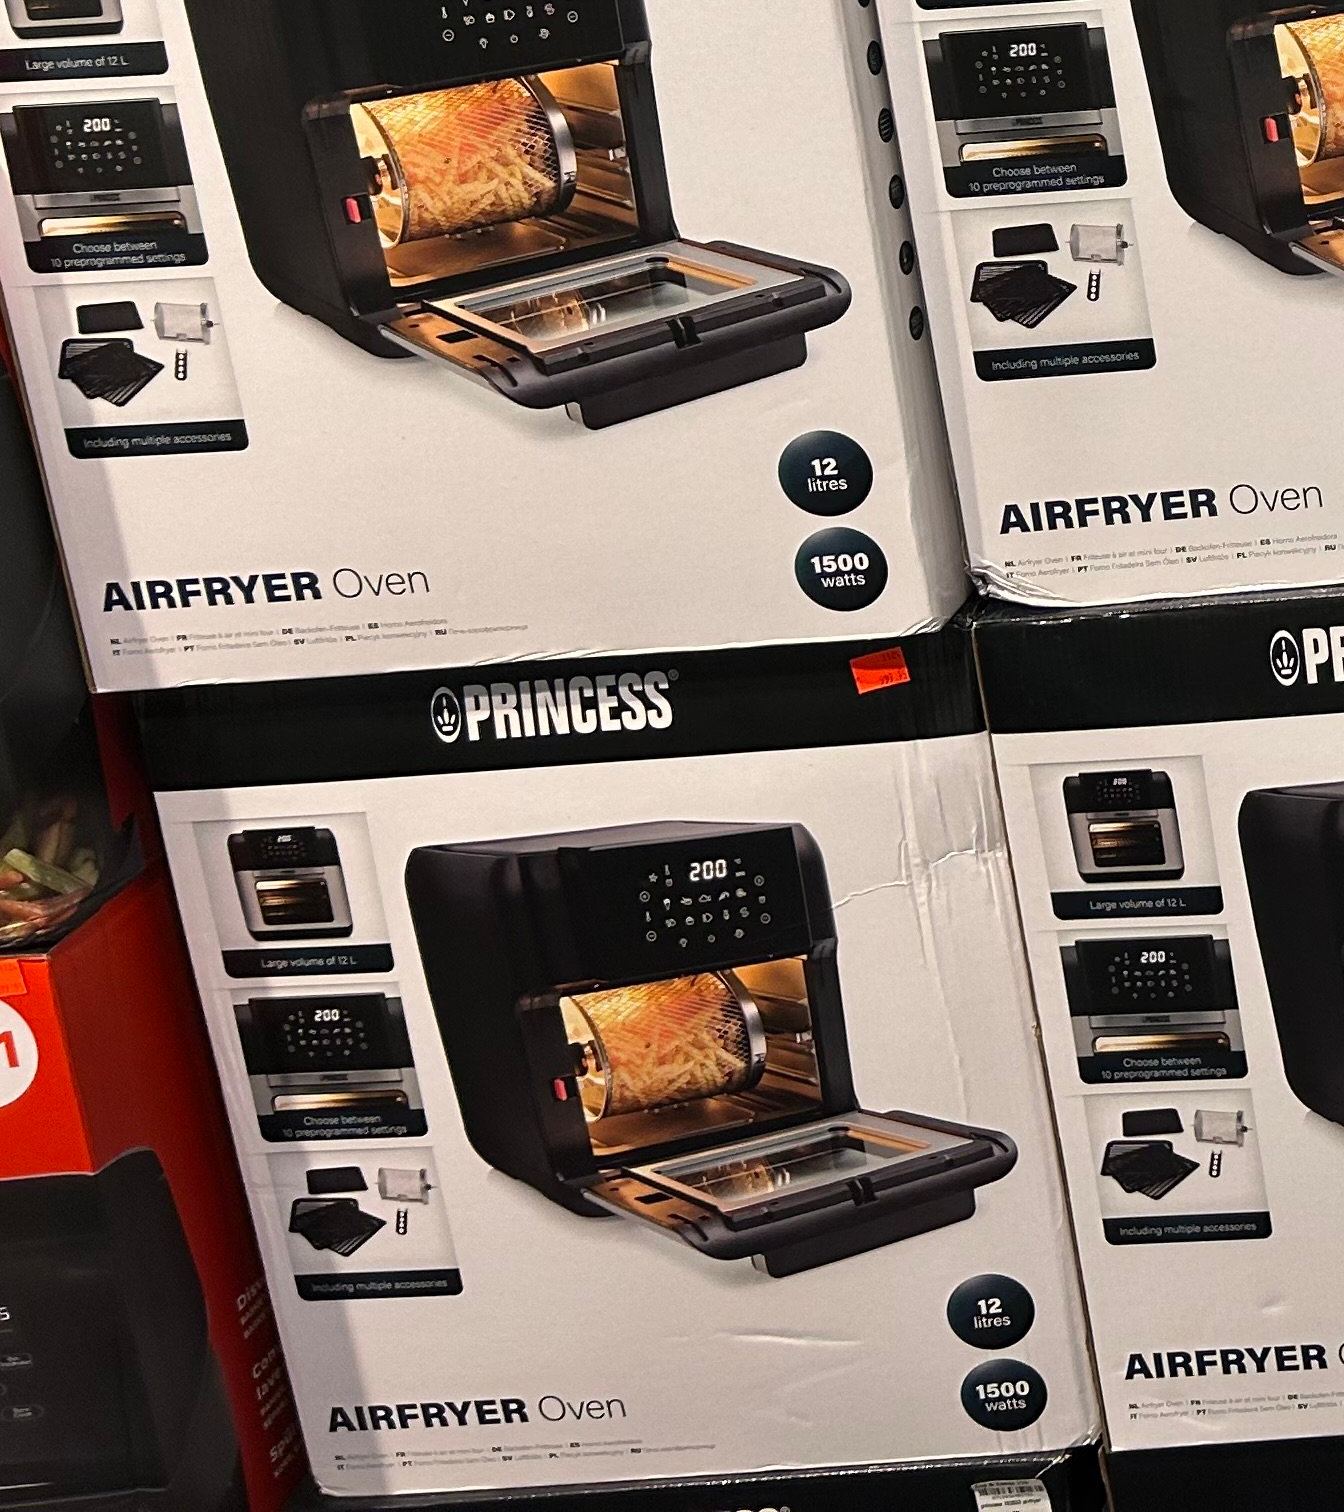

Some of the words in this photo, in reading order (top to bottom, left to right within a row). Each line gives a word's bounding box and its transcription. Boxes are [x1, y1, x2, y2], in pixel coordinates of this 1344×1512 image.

[25, 59, 55, 71] Large
[56, 57, 93, 69] volume
[95, 56, 105, 67] of
[107, 56, 118, 65] 12
[120, 55, 129, 65] L
[992, 166, 1031, 178] Choose
[1033, 164, 1078, 175] between
[983, 177, 1064, 193] preprogrammed
[1065, 175, 1105, 188] settings
[72, 242, 111, 254] Choose
[113, 240, 157, 252] between
[64, 254, 144, 269] preprogrammed
[146, 252, 186, 264] settings
[992, 359, 1038, 371] Including
[1039, 356, 1079, 368] multiple
[1082, 351, 1140, 364] accessories
[84, 437, 130, 449] Including
[131, 435, 171, 447] multiple
[173, 433, 232, 444] accessories
[811, 457, 838, 476] 12
[807, 475, 848, 492] litres
[1000, 487, 1219, 534] AIRFRYER
[1229, 483, 1323, 515] Oven
[810, 552, 869, 574] 1500
[821, 573, 866, 588] watts
[103, 571, 323, 612] AIRFRYER
[333, 567, 430, 598] Oven
[463, 671, 674, 741] PRINCESS
[690, 859, 727, 881] 200
[1089, 900, 1117, 911] Large
[1119, 898, 1153, 909] volume
[1155, 897, 1165, 907] of
[1166, 897, 1178, 907] 12
[1179, 897, 1187, 907] L
[261, 958, 288, 970] Large
[290, 957, 324, 967] volume
[326, 956, 336, 966] of
[337, 956, 348, 965] 12
[349, 955, 357, 965] L
[1123, 1057, 1159, 1068] Choose
[1161, 1055, 1201, 1066] between
[1113, 1067, 1188, 1080] preprogrammed
[304, 1116, 339, 1126] Choose
[341, 1114, 381, 1125] between
[295, 1126, 369, 1139] preprogrammed
[1119, 1226, 1162, 1237] Including
[1164, 1224, 1200, 1234] multiple
[1203, 1222, 1257, 1232] accessories
[394, 1279, 448, 1289] accessories
[977, 1298, 1003, 1314] 12
[974, 1315, 1012, 1329] litres
[1125, 1344, 1328, 1380] AIRFRYER
[976, 1380, 1030, 1399] 1500
[985, 1398, 1027, 1412] watts
[329, 1397, 529, 1432] AIRFRYER
[538, 1395, 627, 1422] Oven
